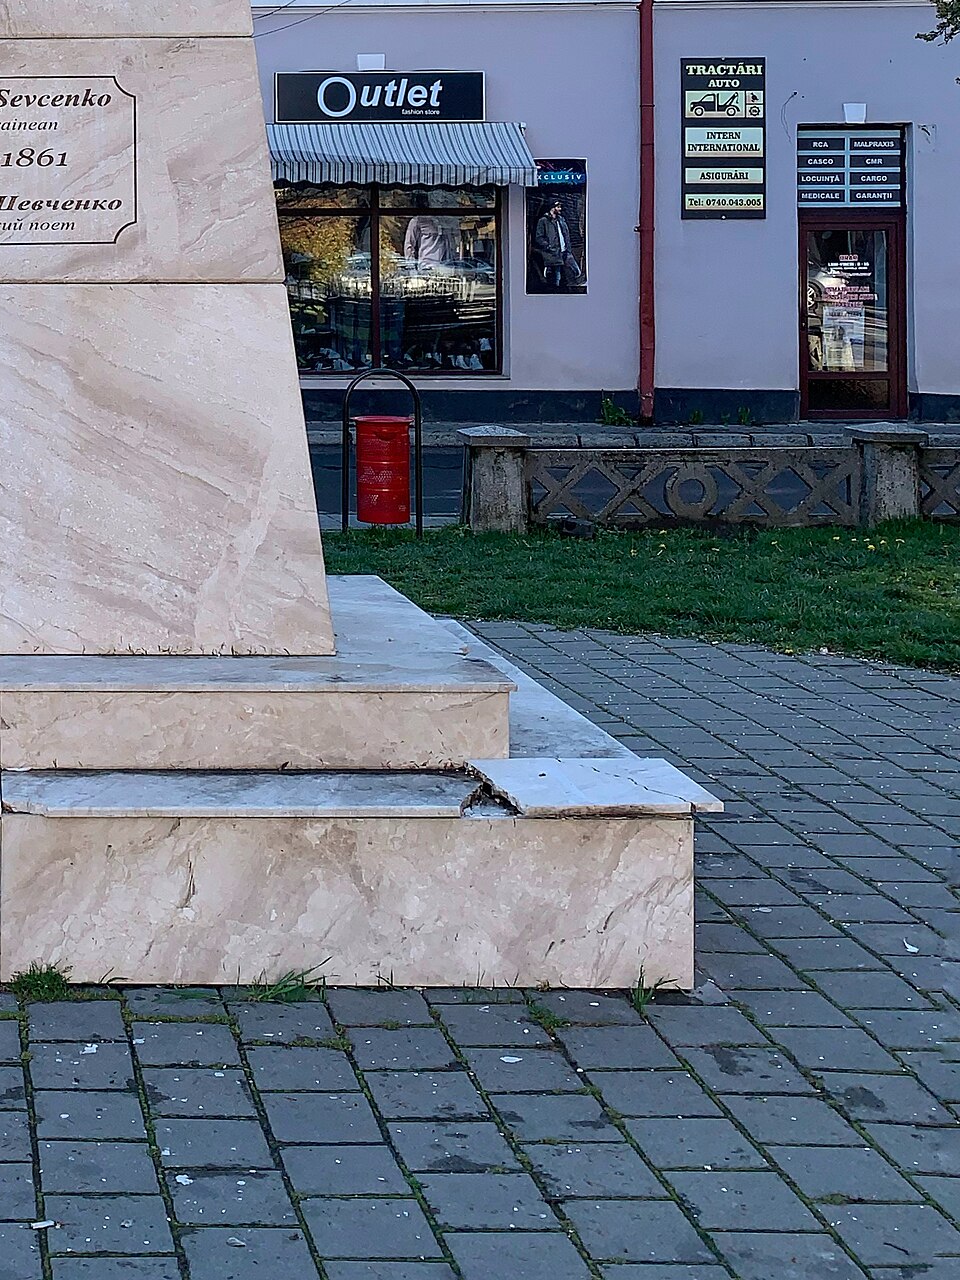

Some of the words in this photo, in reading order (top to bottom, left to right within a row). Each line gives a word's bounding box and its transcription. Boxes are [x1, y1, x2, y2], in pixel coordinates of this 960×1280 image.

[707, 79, 741, 88] AUTO
[317, 76, 443, 118] Outlet
[706, 131, 742, 140] INTERN
[687, 143, 760, 152] INTERNATIONAL
[688, 198, 704, 207] Tel:
[706, 198, 762, 207] 0740.043.005
[28, 221, 75, 231] поет
